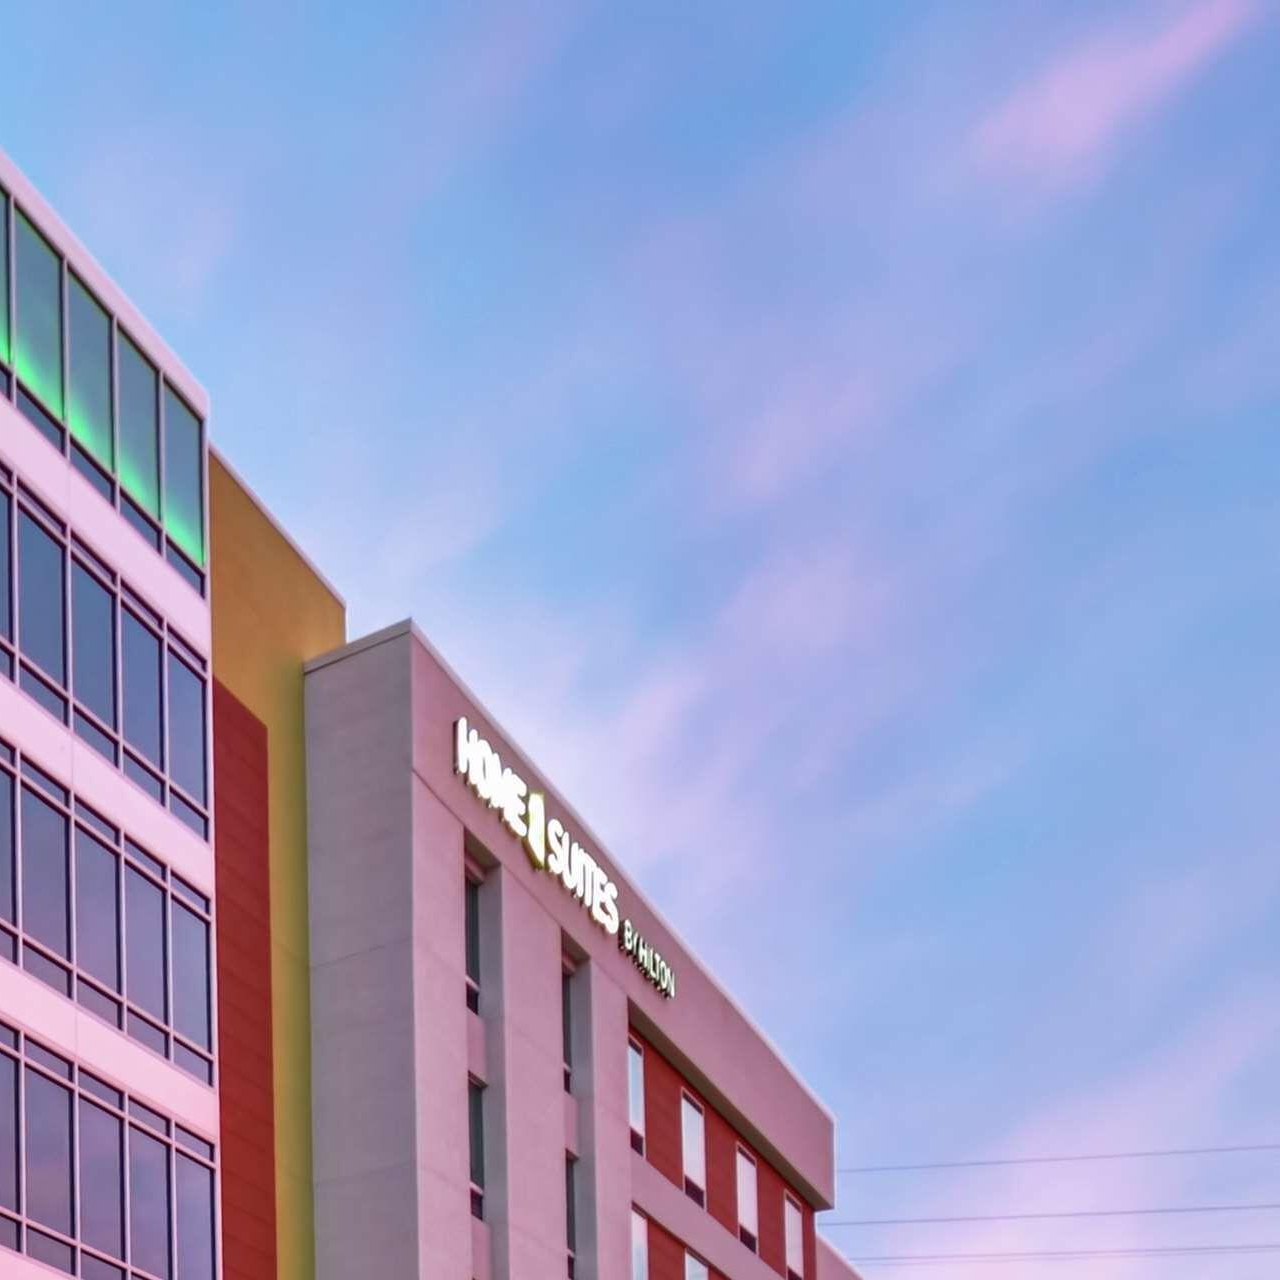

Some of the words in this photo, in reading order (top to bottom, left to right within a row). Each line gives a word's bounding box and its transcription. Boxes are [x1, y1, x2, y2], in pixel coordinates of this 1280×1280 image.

[457, 716, 528, 837] HOME
[547, 818, 620, 934] SUITES
[638, 936, 675, 998] HILTON
